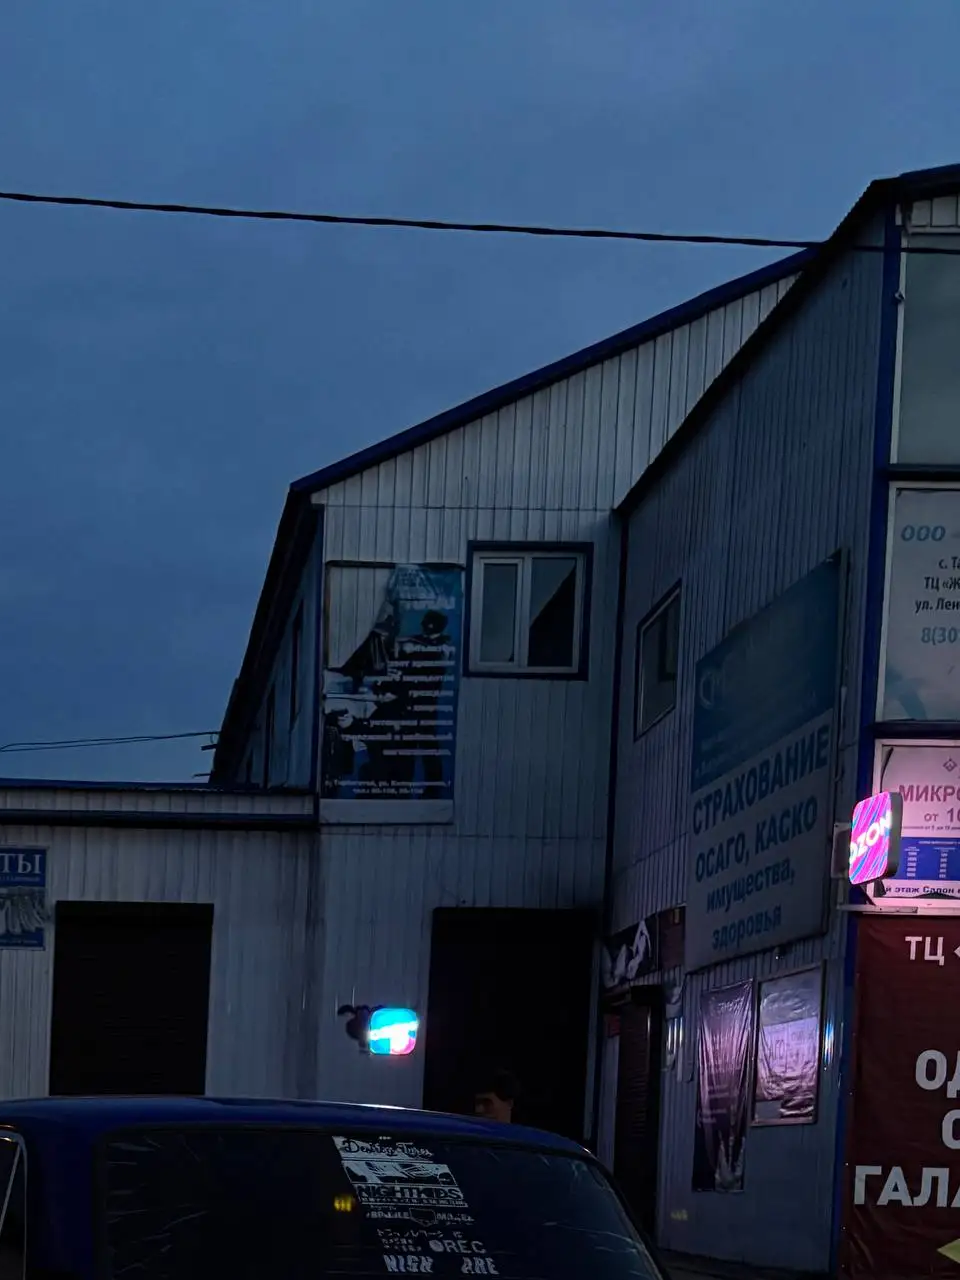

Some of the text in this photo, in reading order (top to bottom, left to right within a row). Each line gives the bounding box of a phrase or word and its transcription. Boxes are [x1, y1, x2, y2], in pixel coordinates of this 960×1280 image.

[924, 576, 940, 592] ТЦ
[915, 600, 933, 614] ул.
[693, 724, 830, 835] СТРАХОВАНИЕ
[899, 785, 960, 802] МИКР
[924, 813, 939, 822] от
[696, 796, 818, 882] ОСАГО, КАСКО
[707, 857, 795, 913] имущества,
[712, 905, 781, 950] здоровья
[904, 936, 945, 966] ТЦ
